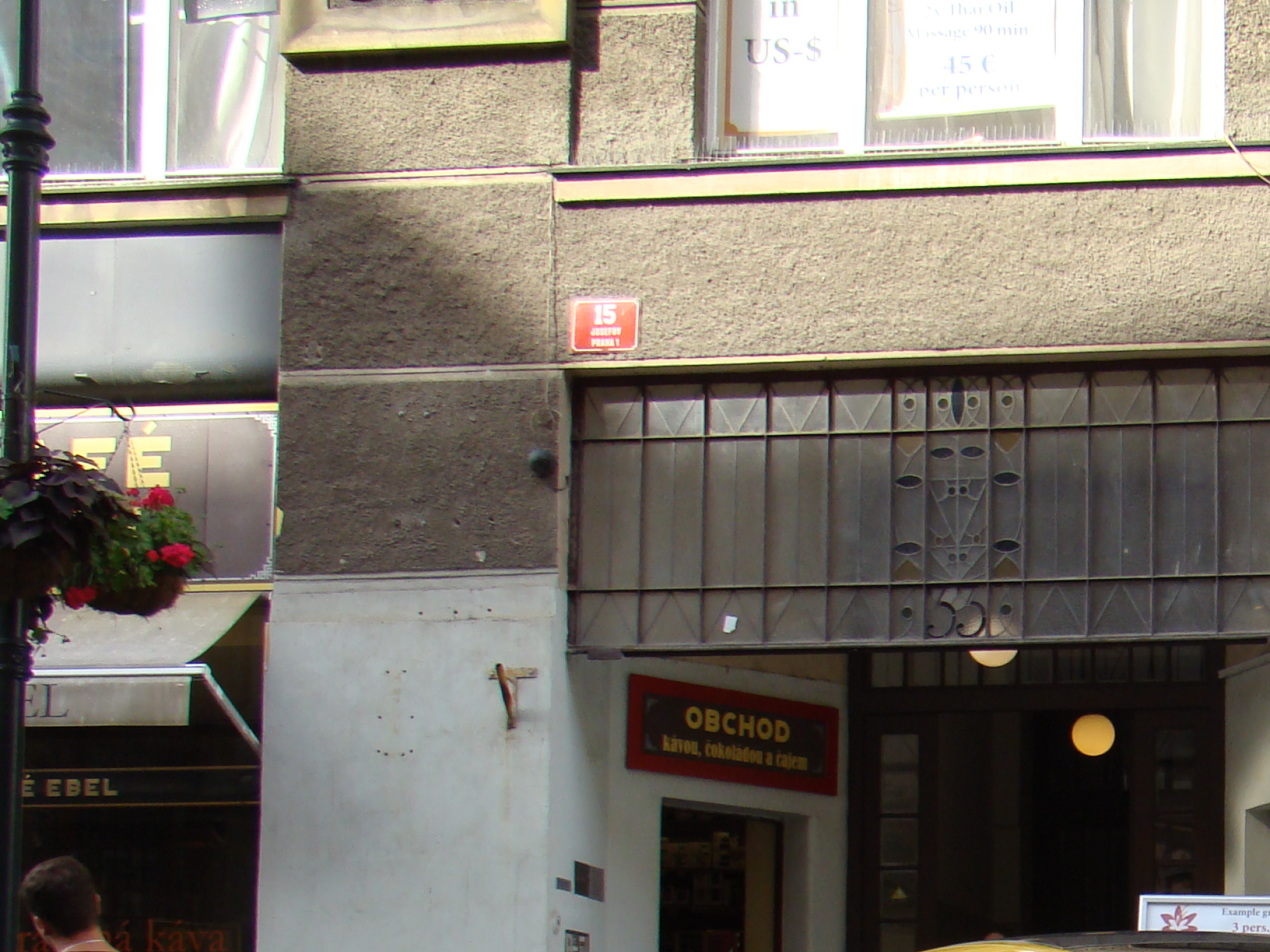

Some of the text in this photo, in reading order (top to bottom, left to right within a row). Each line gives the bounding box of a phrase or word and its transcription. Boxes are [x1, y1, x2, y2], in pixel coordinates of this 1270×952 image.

[998, 22, 1028, 36] min
[745, 36, 822, 65] US-$
[944, 54, 972, 75] 45
[919, 81, 1020, 100] per person
[594, 304, 617, 325] 15
[685, 706, 791, 744] OBCHOD
[765, 752, 774, 767] a
[46, 777, 119, 798] EBEL
[1221, 907, 1261, 918] Example
[1232, 922, 1239, 933] 3
[1242, 923, 1270, 934] pers.
